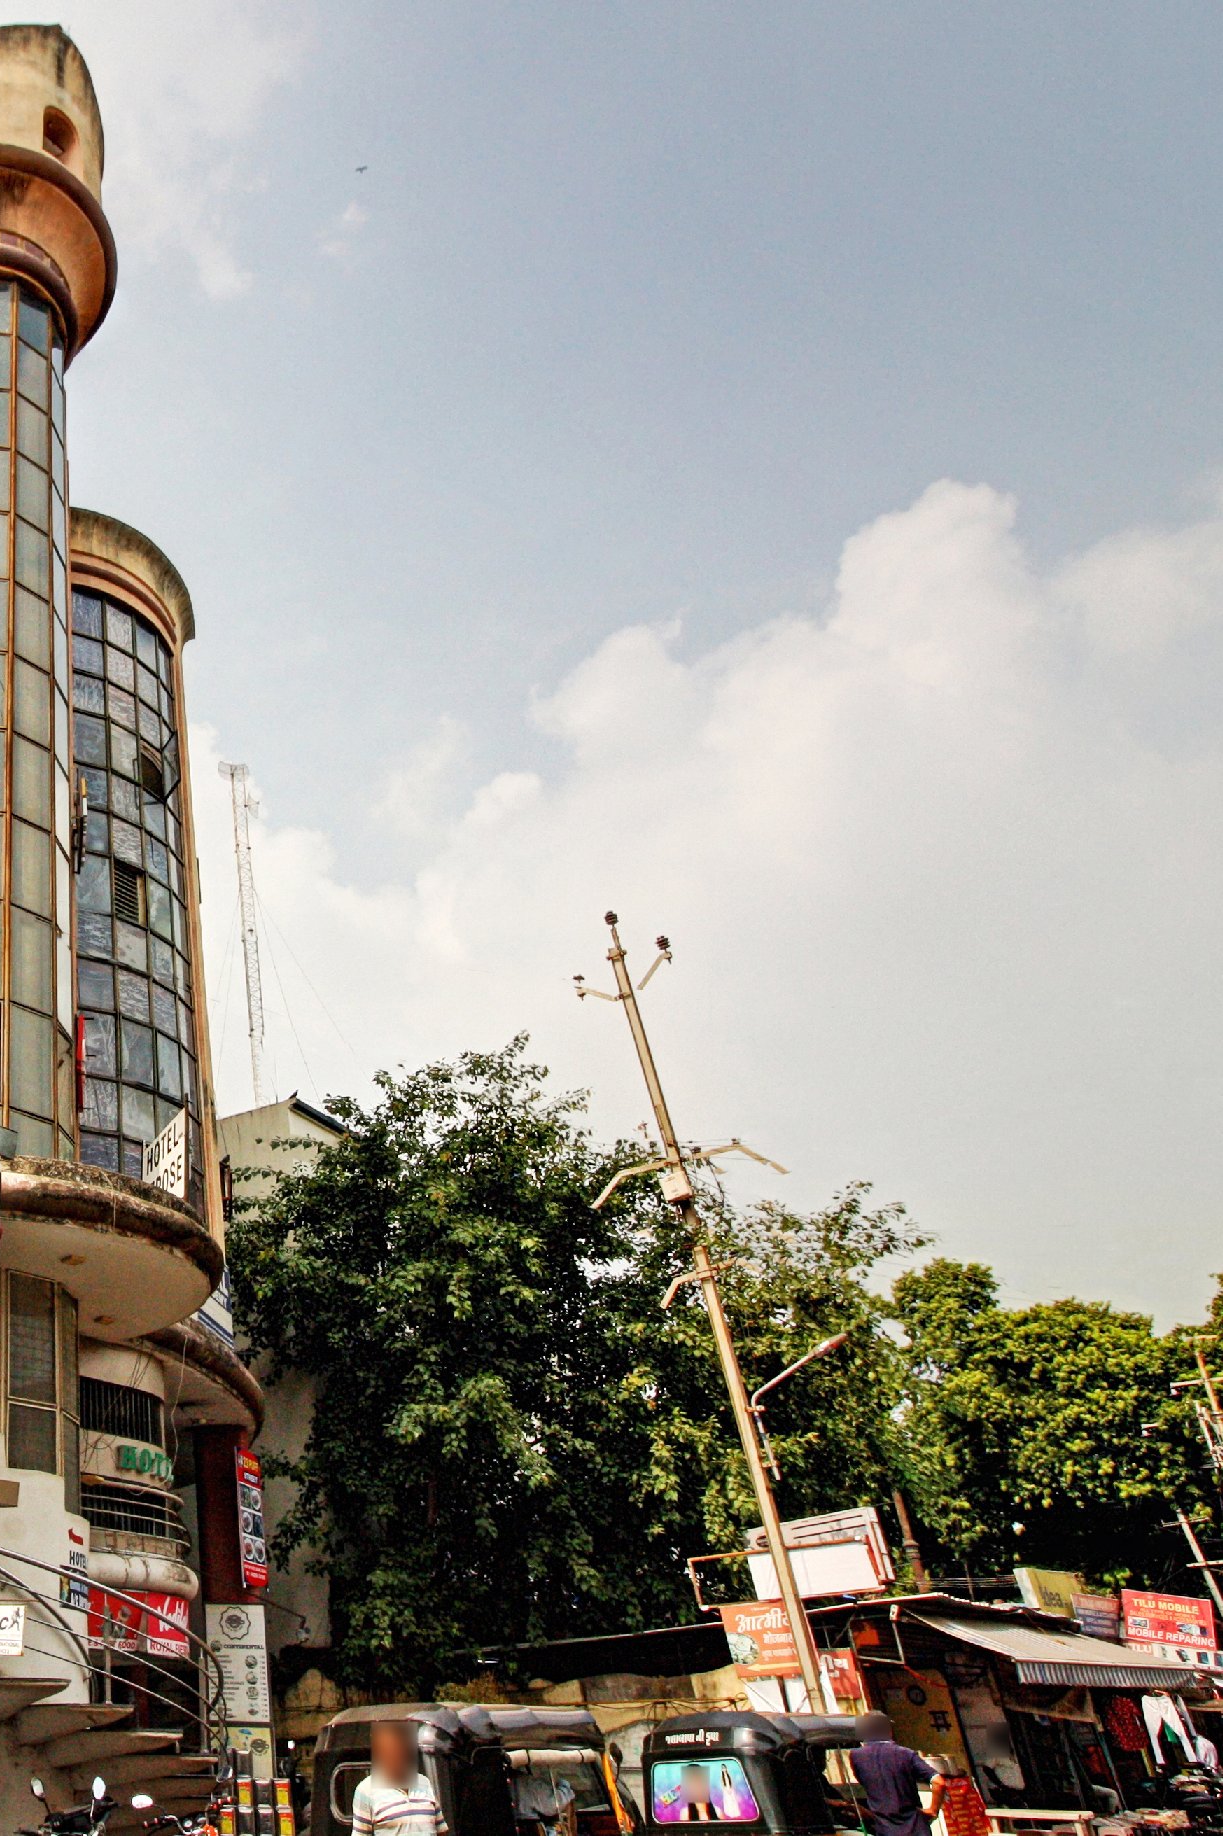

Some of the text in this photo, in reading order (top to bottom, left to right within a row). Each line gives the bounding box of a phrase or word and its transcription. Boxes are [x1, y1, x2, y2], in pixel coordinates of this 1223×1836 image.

[146, 1123, 179, 1176] HOTEL
[117, 1445, 174, 1481] HOT
[1132, 1598, 1156, 1609] TILU
[1158, 1601, 1200, 1615] MOBILE
[1127, 1626, 1216, 1648] MOBILE REPARING
